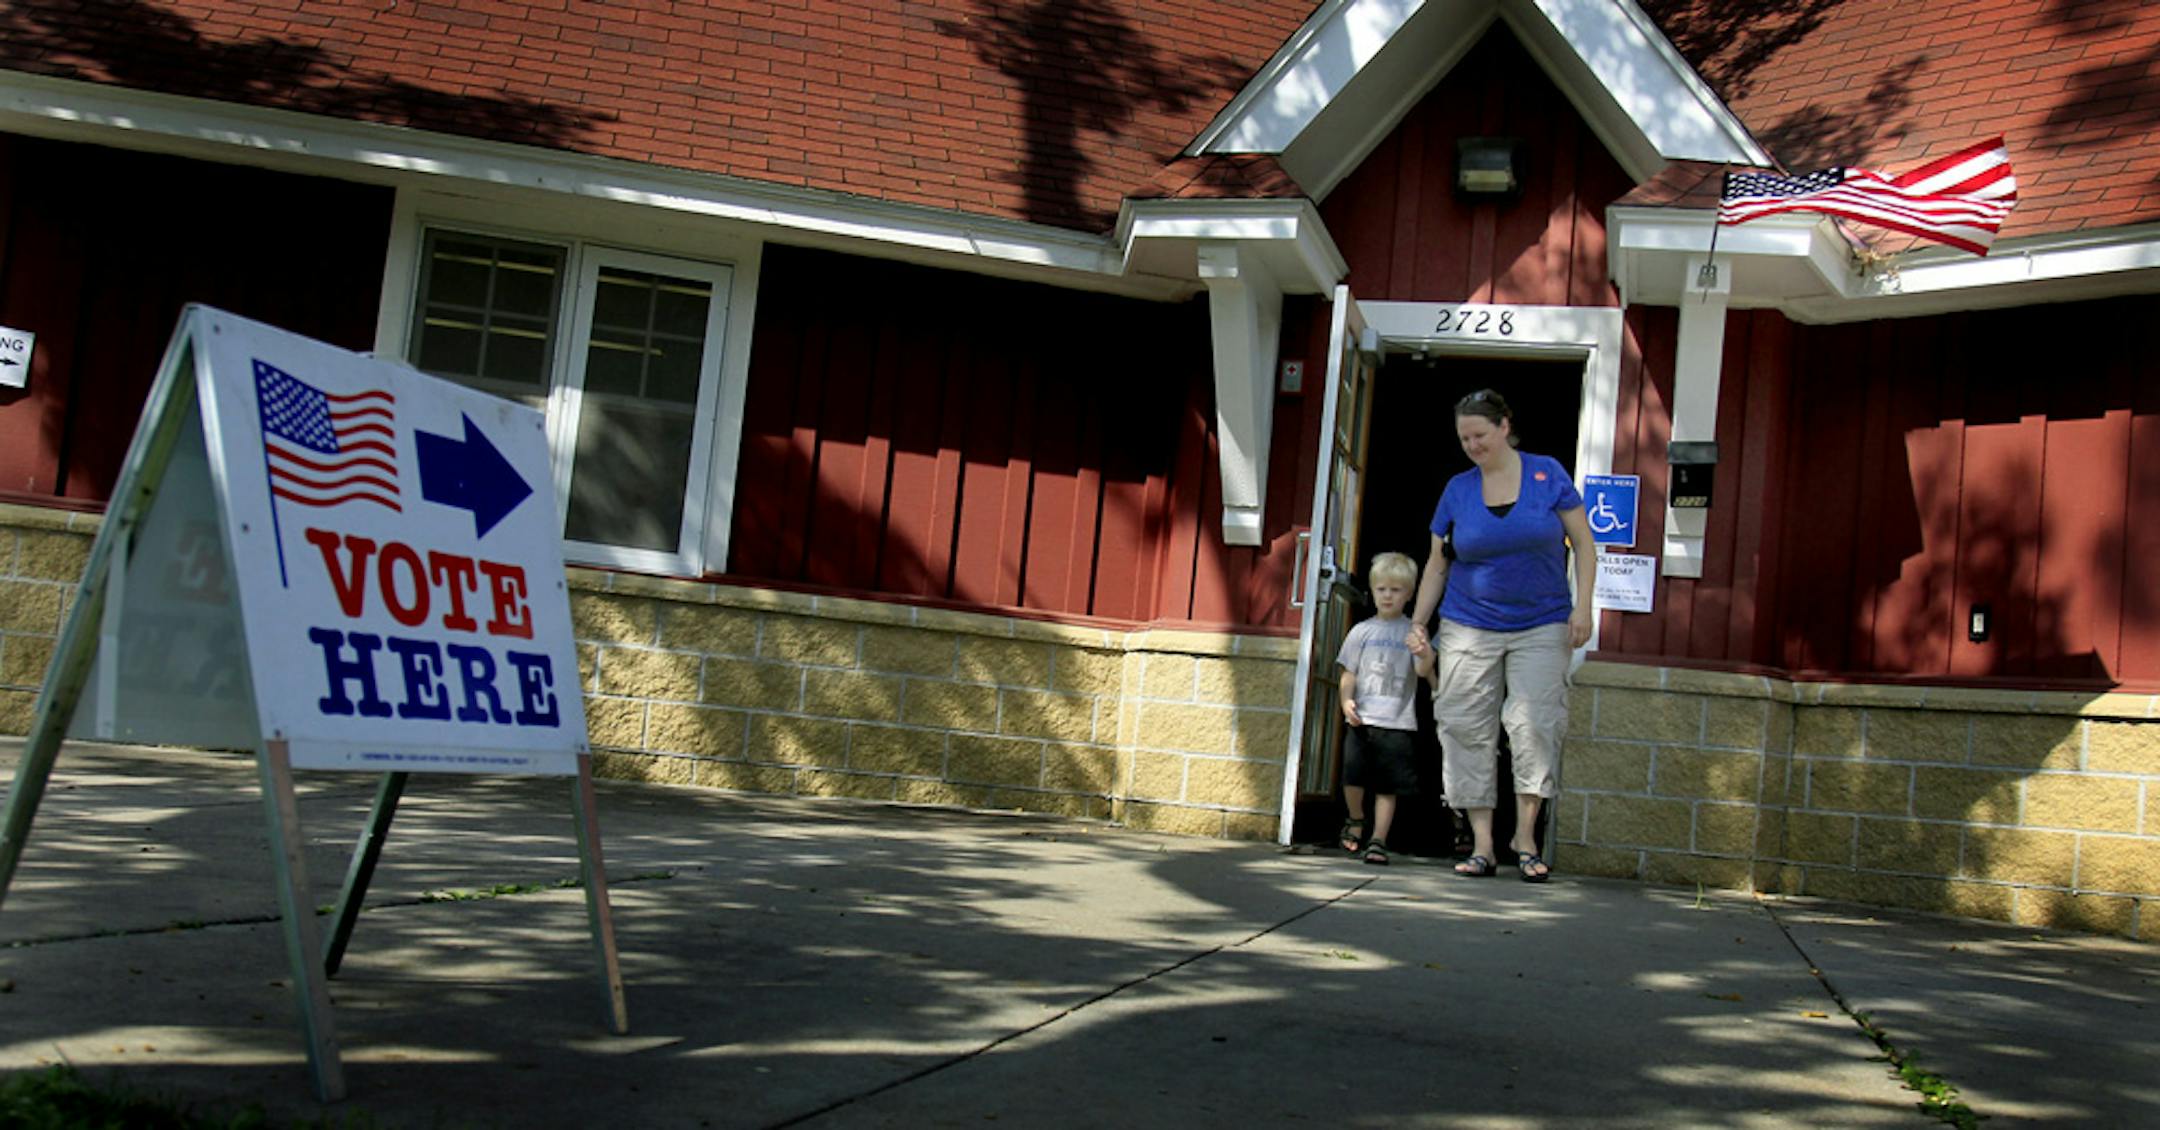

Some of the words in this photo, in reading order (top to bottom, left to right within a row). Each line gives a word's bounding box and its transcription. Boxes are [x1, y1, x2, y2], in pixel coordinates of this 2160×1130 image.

[1436, 309, 1514, 335] 2728
[0, 337, 24, 352] NG
[1596, 555, 1620, 565] OLLS
[1622, 557, 1649, 567] OPEN
[1603, 566, 1634, 576] TODAY
[305, 527, 534, 640] VOTE
[308, 626, 560, 728] HERE
